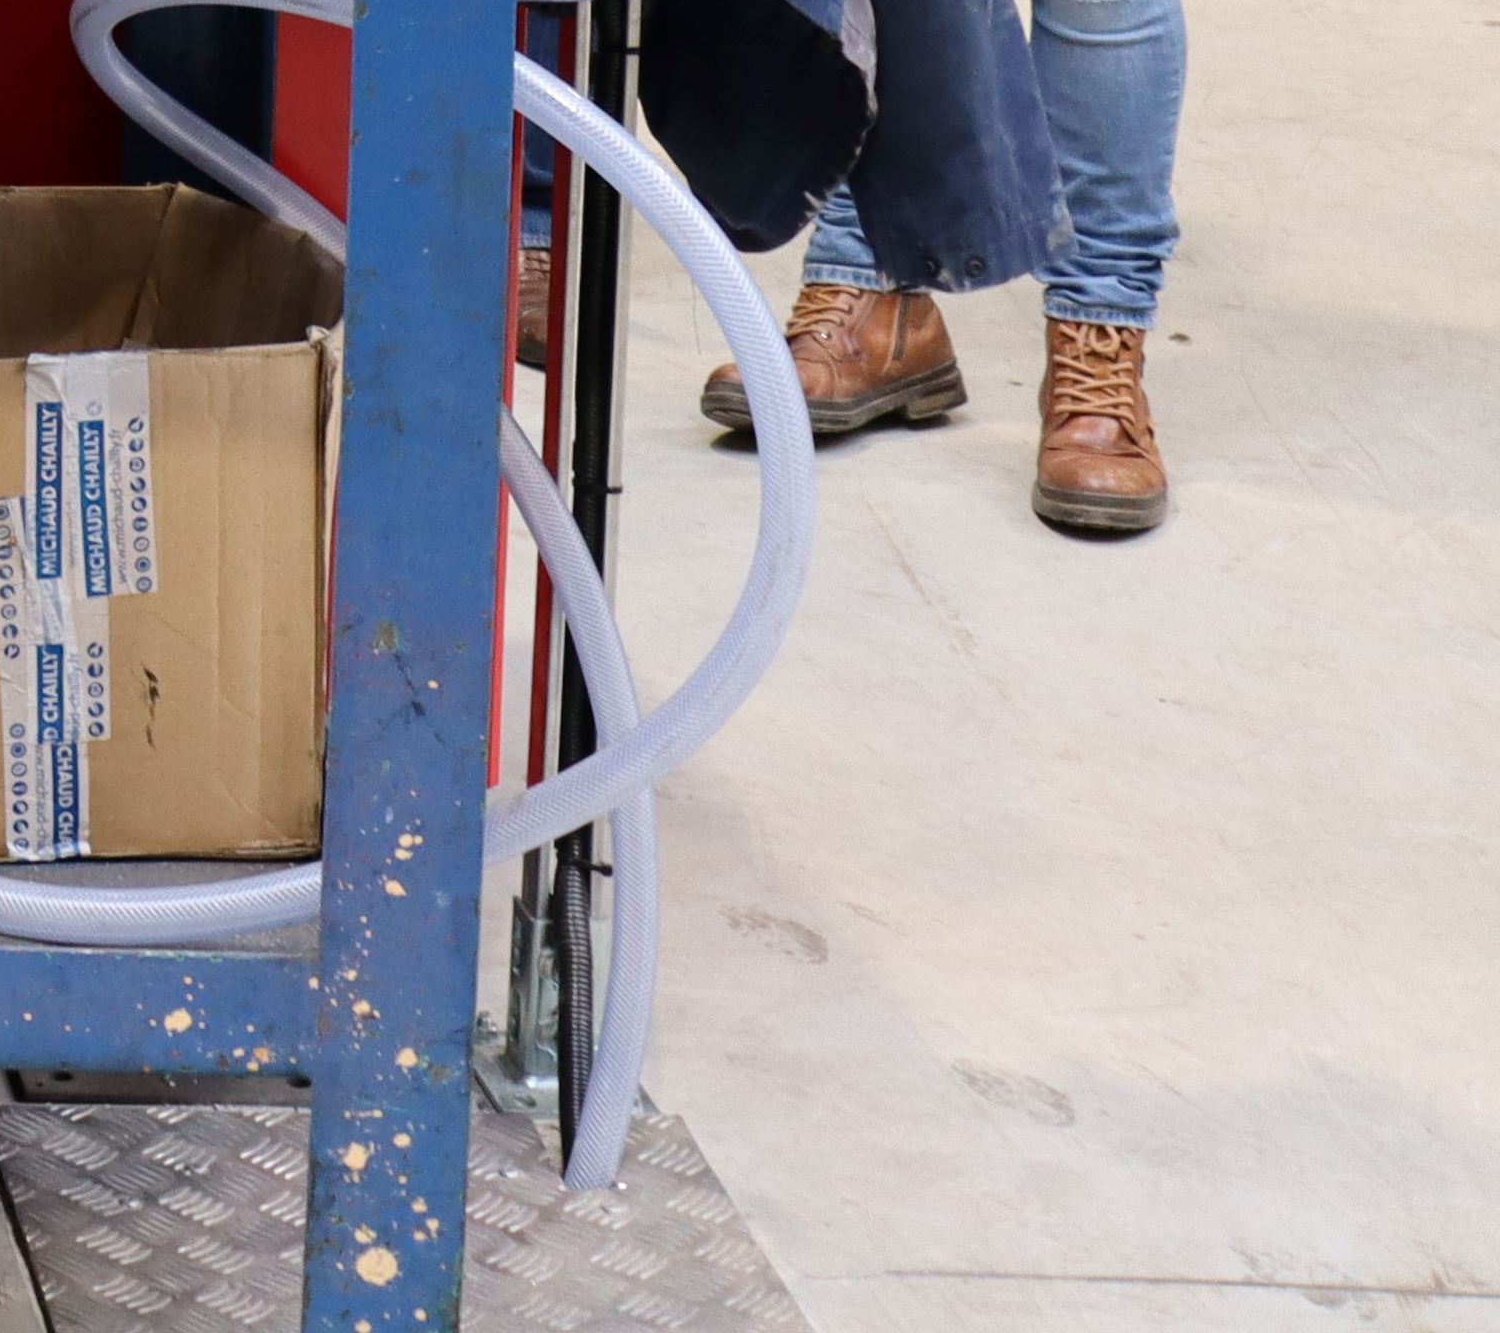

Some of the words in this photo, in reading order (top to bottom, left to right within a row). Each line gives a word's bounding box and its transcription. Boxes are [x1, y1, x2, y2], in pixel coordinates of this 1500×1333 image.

[41, 408, 57, 481] CHAILLY
[83, 427, 100, 501] CHAILLY
[41, 486, 57, 575] MICHAUD
[85, 504, 107, 593] MICHAUD
[42, 651, 59, 722] CHAILLY
[57, 743, 74, 808] CHAUD
